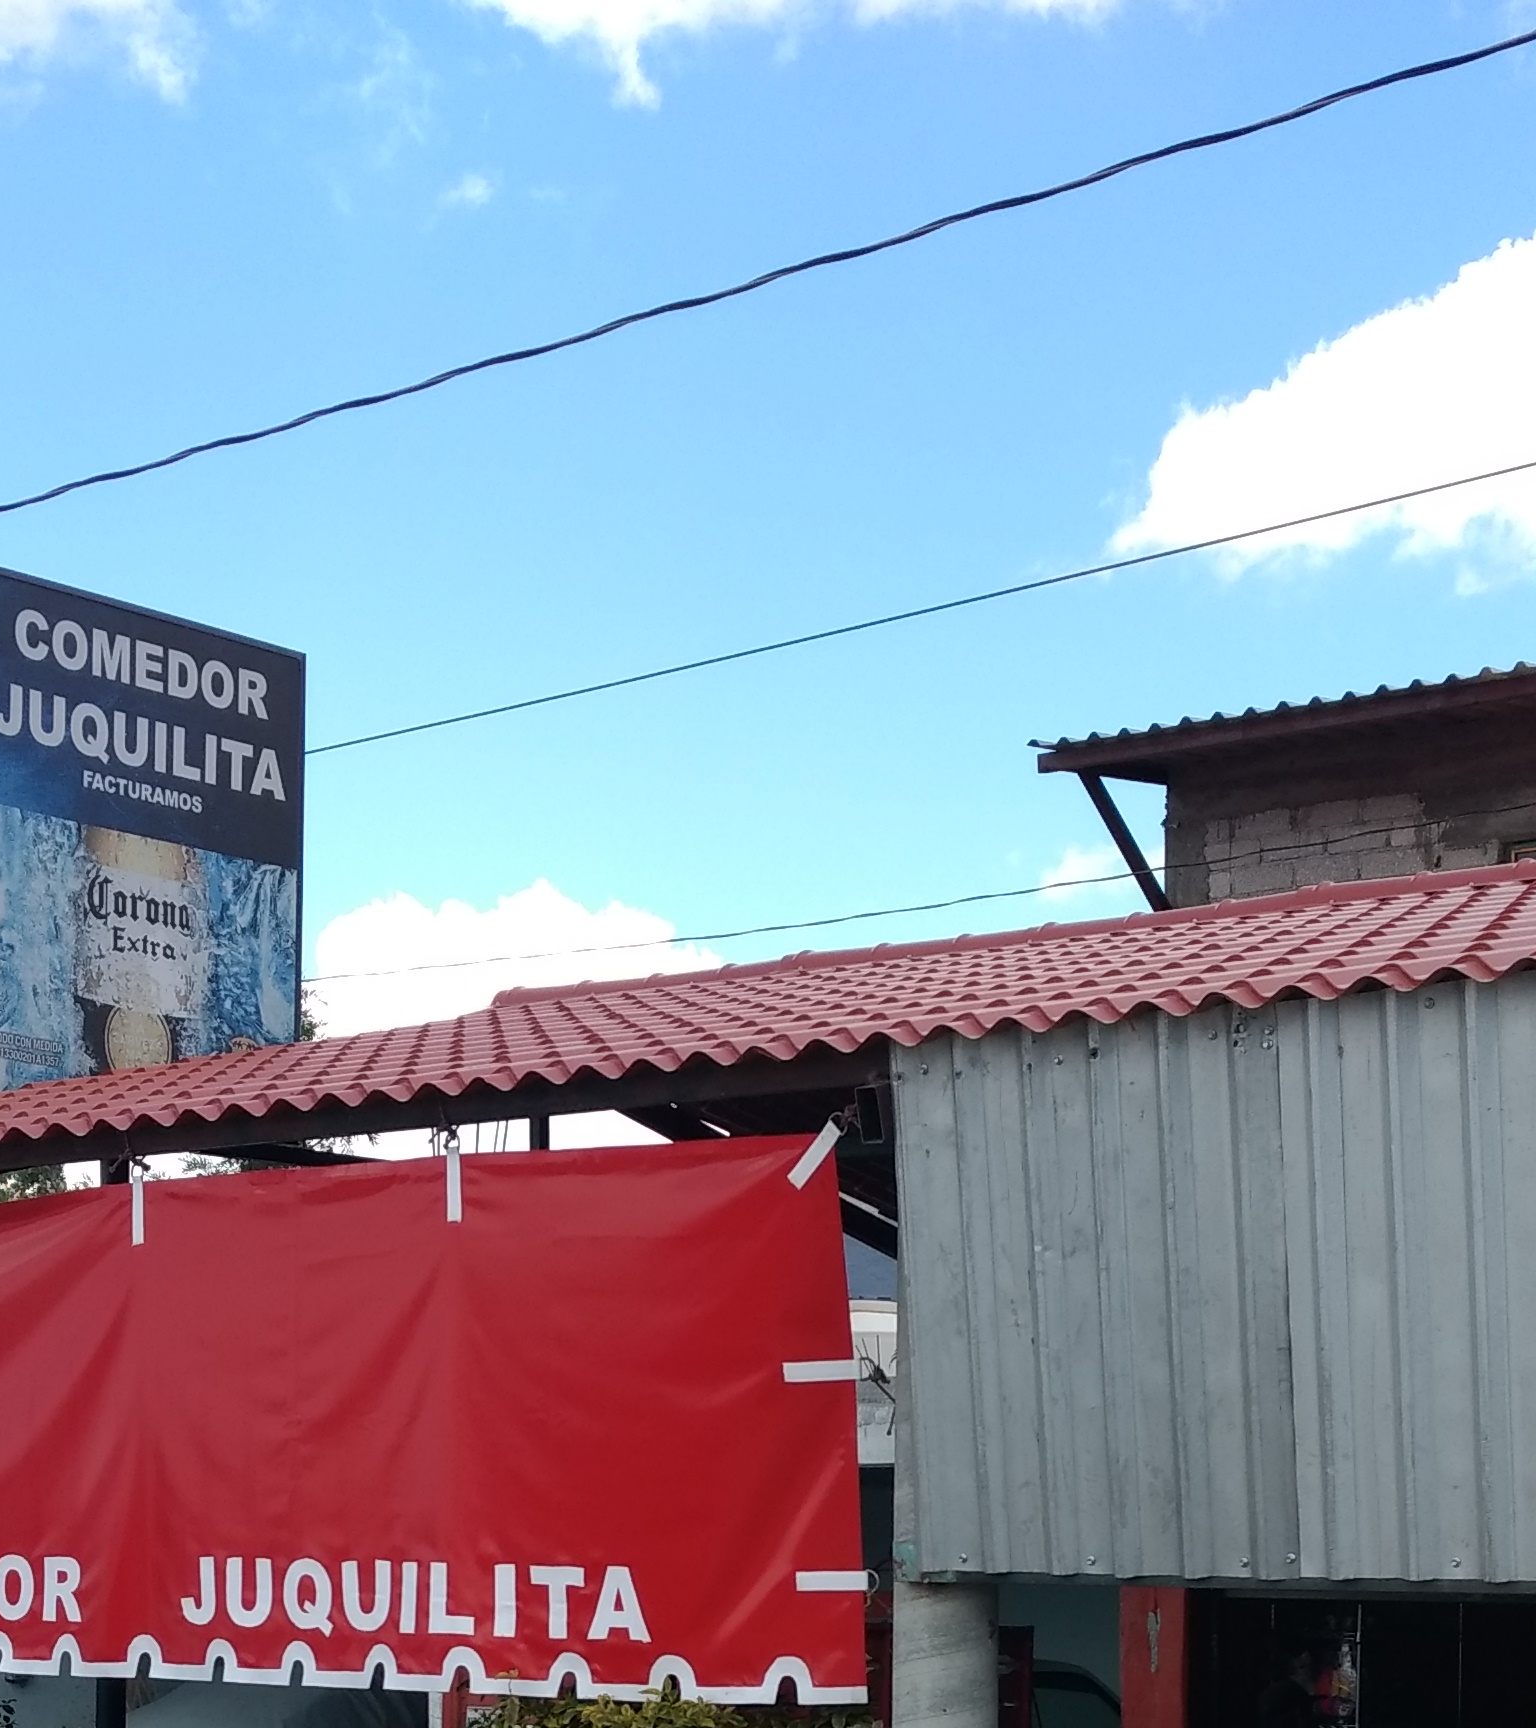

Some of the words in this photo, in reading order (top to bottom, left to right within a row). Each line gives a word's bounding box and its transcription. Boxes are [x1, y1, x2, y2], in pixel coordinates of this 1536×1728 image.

[15, 608, 269, 720] COMEDOR
[83, 769, 203, 814] FACTURAMOS
[86, 868, 193, 936] Corona
[111, 925, 177, 961] Extra
[15, 1035, 32, 1048] CON
[33, 1039, 63, 1054] MEDIDA
[180, 1555, 650, 1643] JUQUILITA
